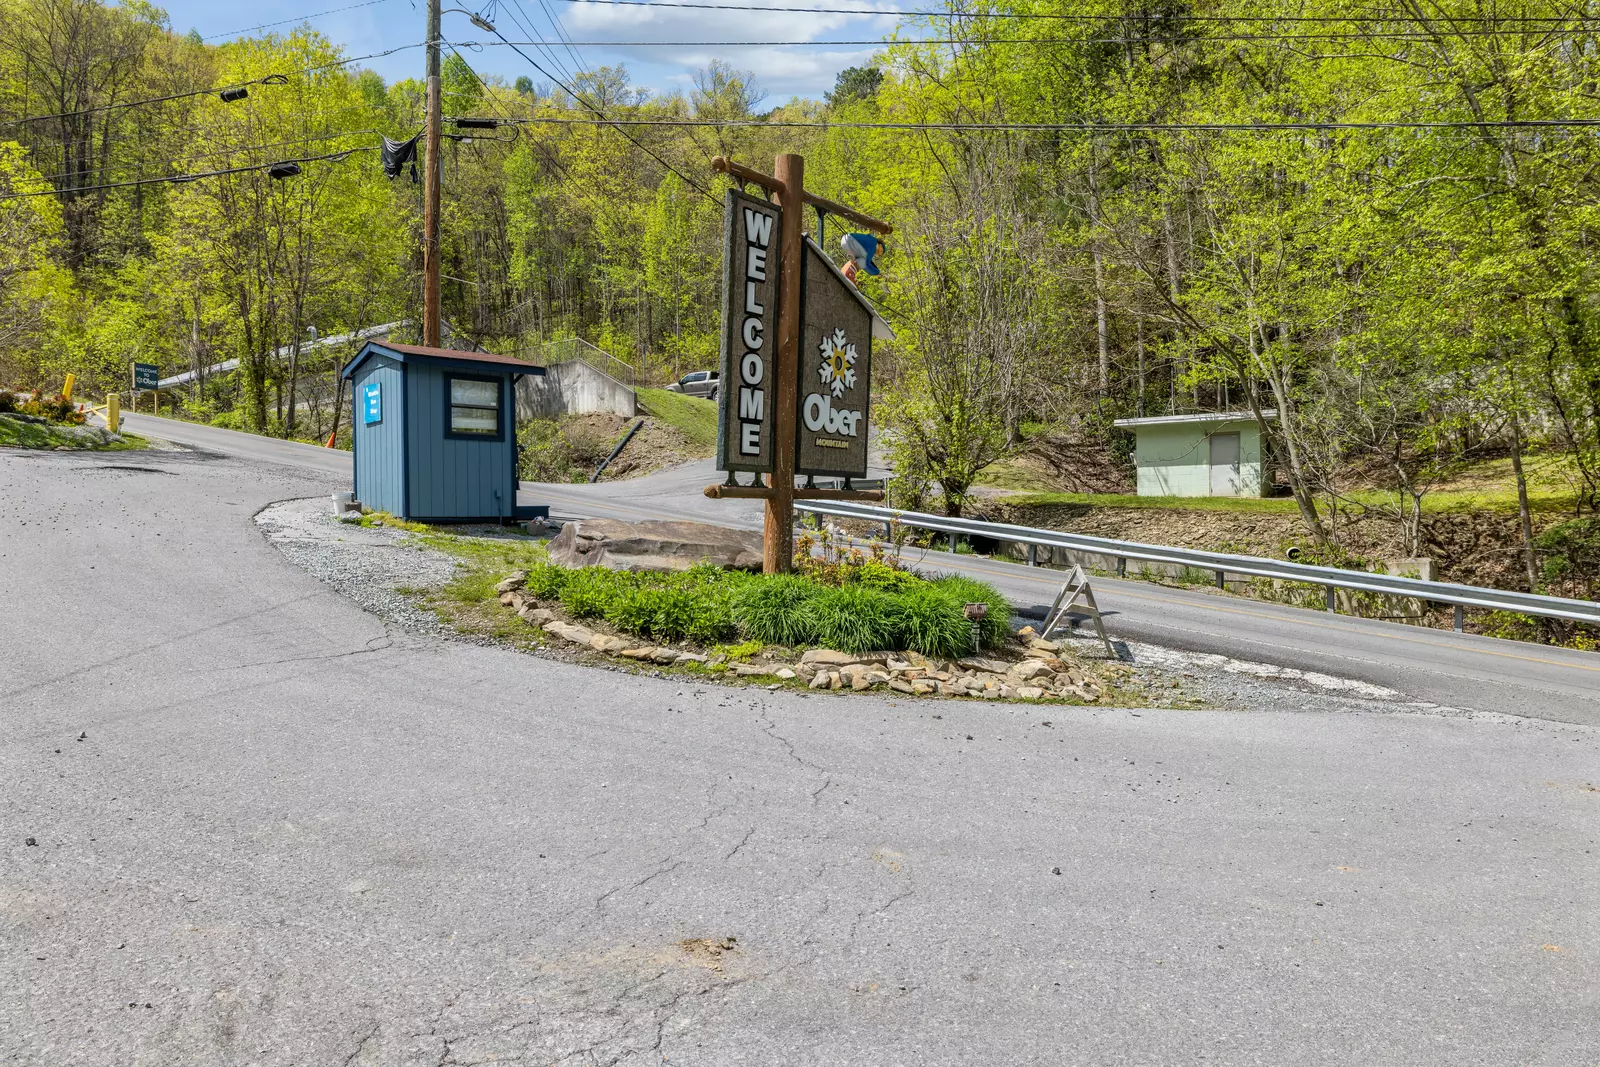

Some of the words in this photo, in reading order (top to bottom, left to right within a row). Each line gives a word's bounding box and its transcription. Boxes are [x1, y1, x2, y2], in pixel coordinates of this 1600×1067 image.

[739, 207, 773, 455] WELCOME
[803, 393, 862, 437] Ober
[815, 438, 850, 450] MOUNTAIN
